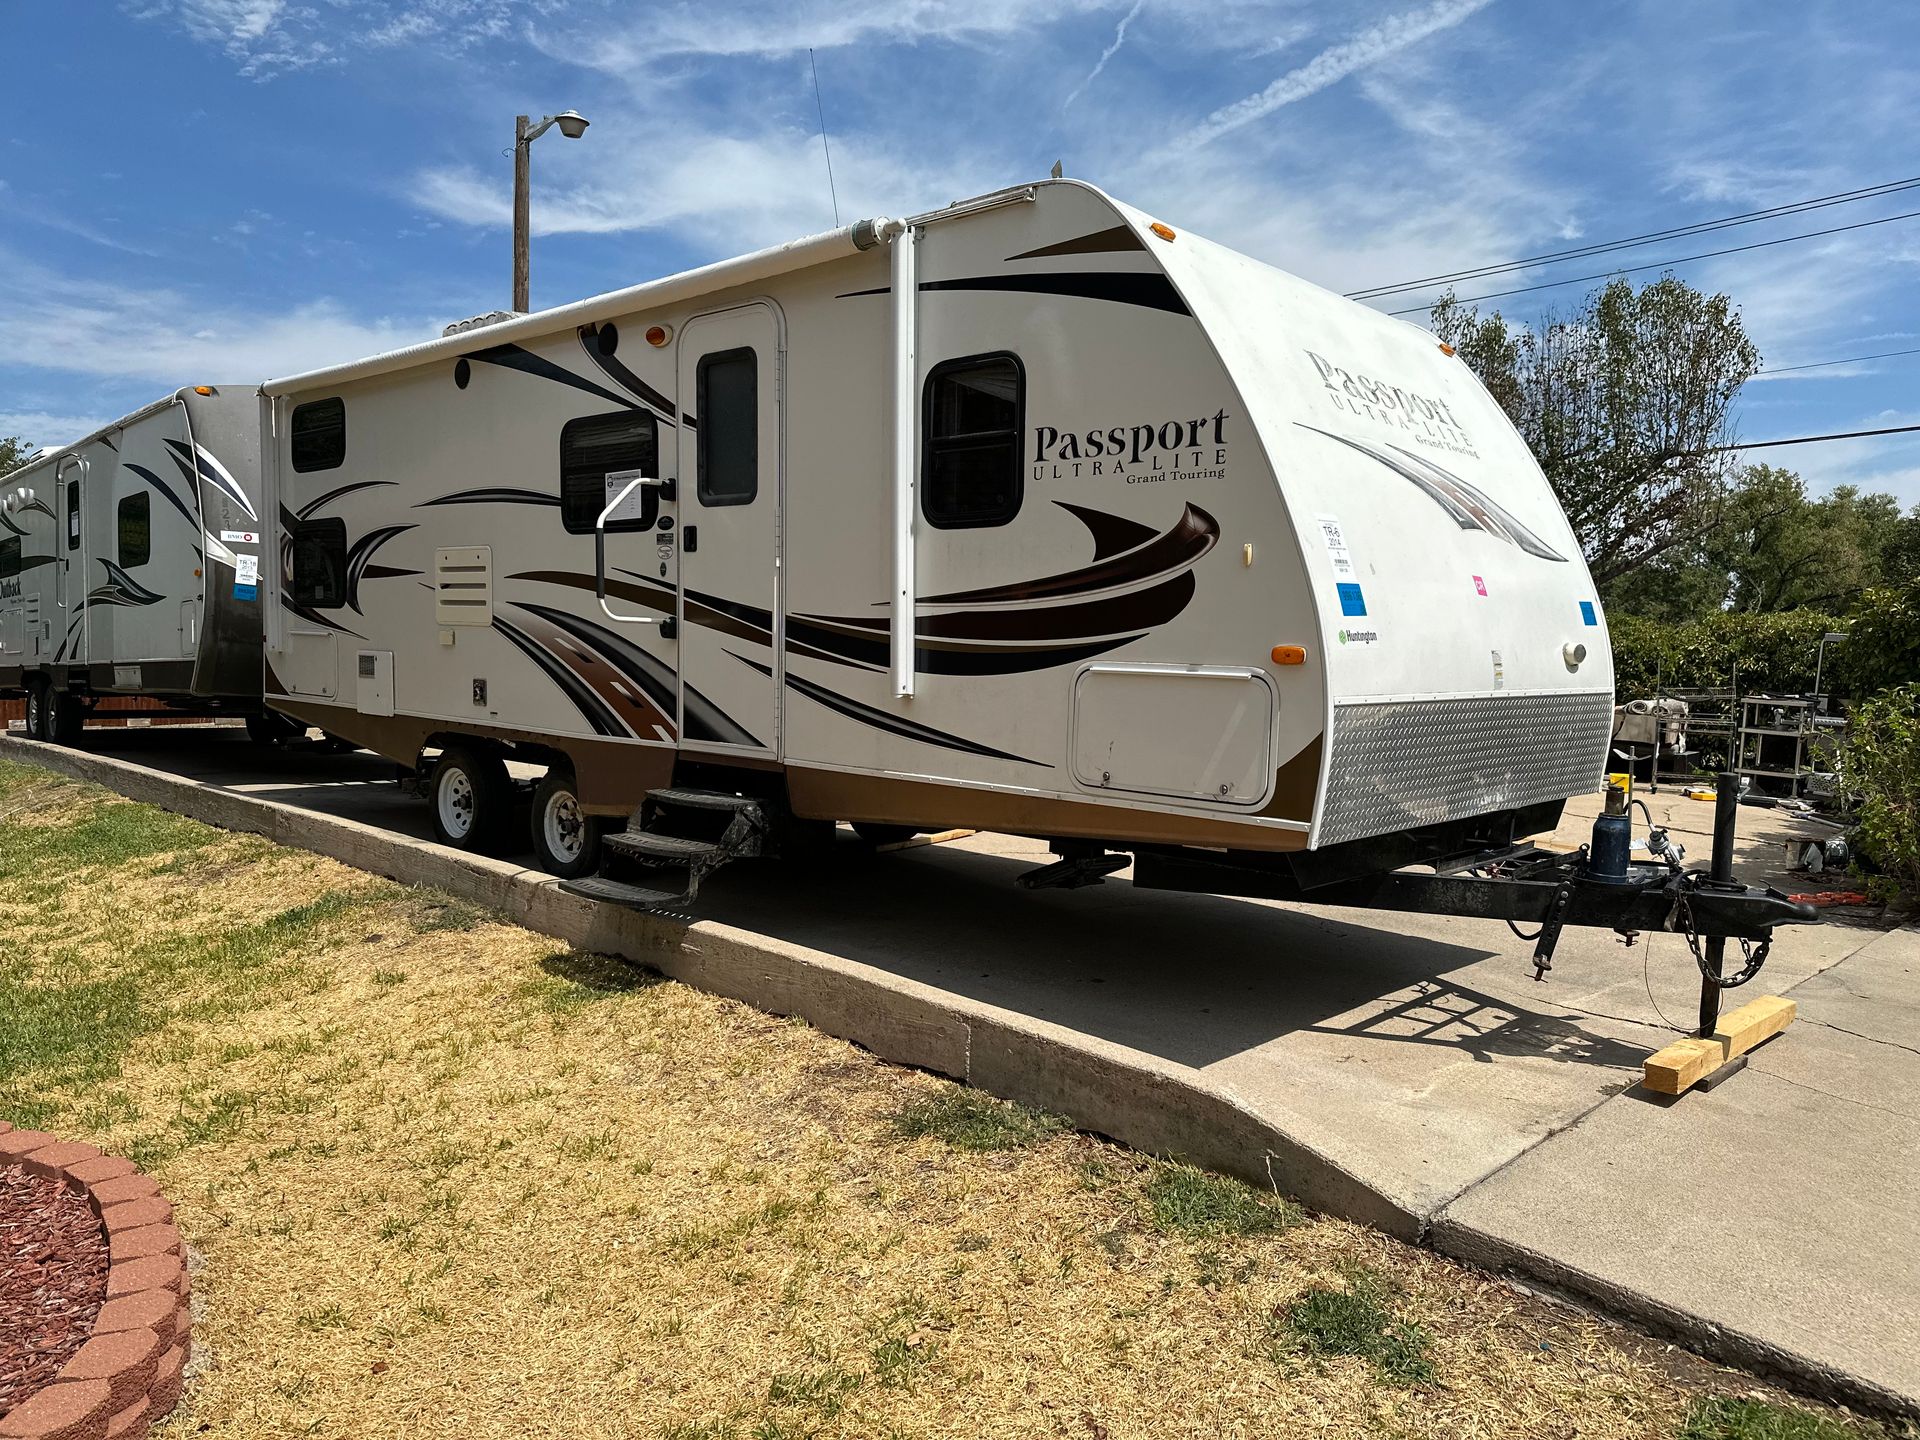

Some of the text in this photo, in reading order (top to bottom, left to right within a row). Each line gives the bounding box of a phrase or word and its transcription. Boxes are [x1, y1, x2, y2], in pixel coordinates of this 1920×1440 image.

[1302, 349, 1463, 430] Passport
[1033, 407, 1230, 464] Passport
[1329, 393, 1473, 447] ULTRA LITE
[1033, 448, 1227, 481] ULTRA LITE
[1126, 467, 1226, 485] Grand Touring
[1346, 630, 1377, 644] Huntington
